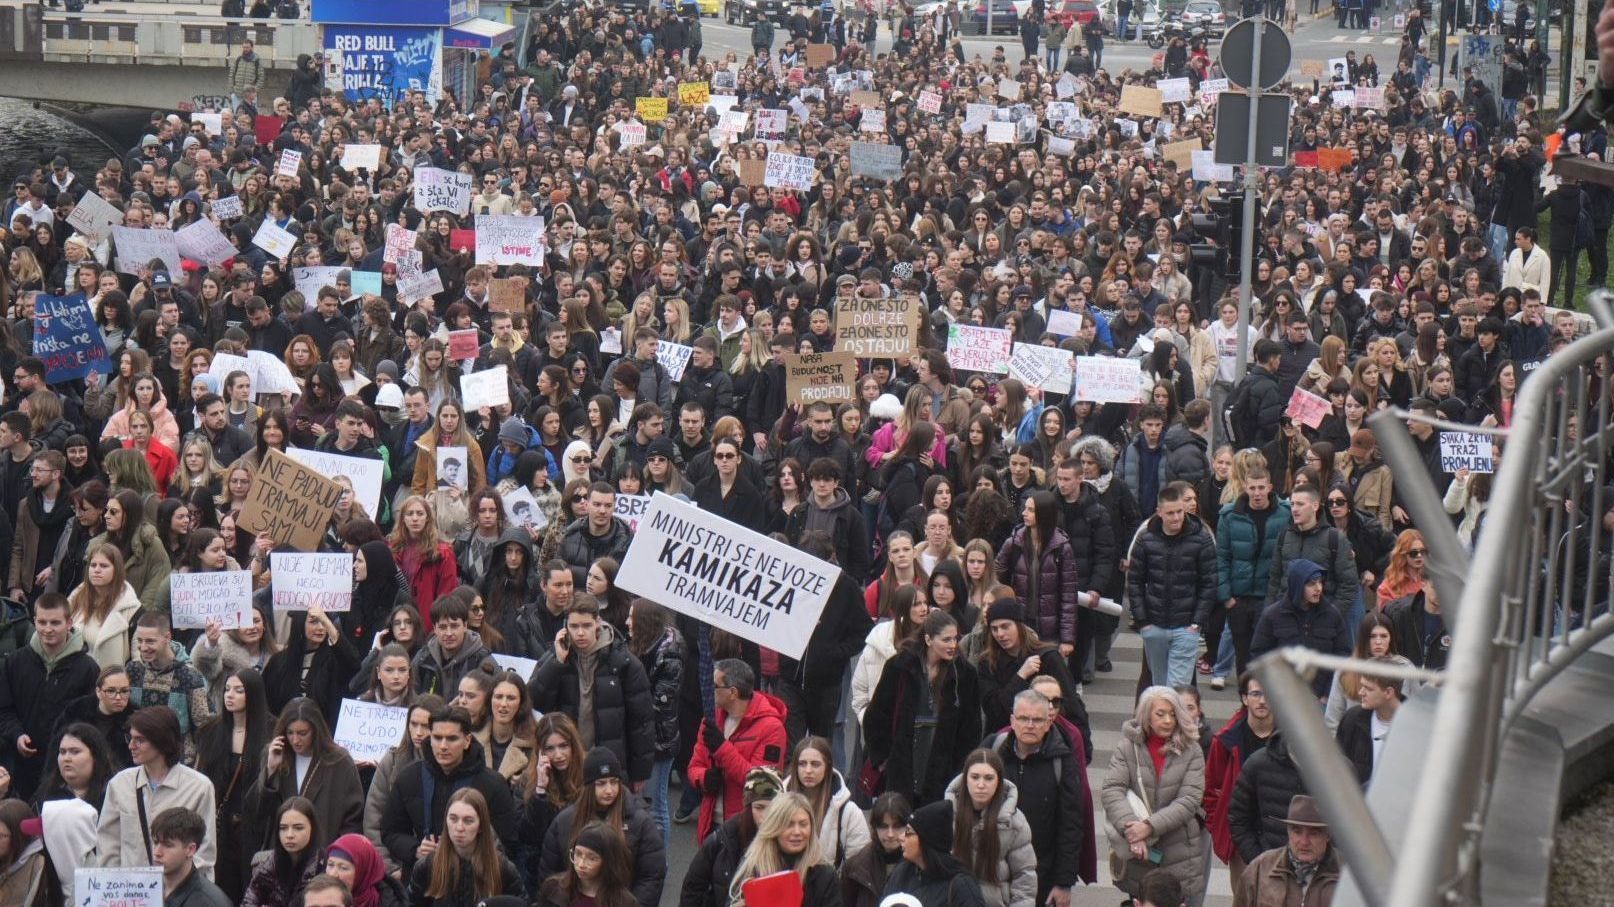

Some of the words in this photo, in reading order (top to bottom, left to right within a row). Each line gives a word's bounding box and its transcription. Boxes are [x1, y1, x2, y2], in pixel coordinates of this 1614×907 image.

[335, 35, 361, 51] RED
[365, 35, 396, 51] BULL
[344, 54, 369, 71] AJE
[455, 174, 472, 189] bori
[447, 186, 458, 198] VI
[840, 299, 858, 312] ZA
[861, 299, 885, 312] ONE
[840, 327, 857, 339] ZA
[857, 326, 883, 339] ONE
[844, 338, 910, 354] OSTAJU!
[810, 375, 829, 386] NIJE
[832, 374, 844, 384] NA
[1441, 432, 1465, 444] SVAKA
[1442, 456, 1493, 472] PROMJENU
[262, 455, 292, 486] NE
[290, 470, 344, 509] PADAJU
[256, 479, 323, 532] TRAMVAJI
[252, 511, 297, 545] SAMI
[651, 510, 732, 557] MINISTRI
[732, 543, 756, 567] SE
[755, 553, 781, 577] NE
[782, 561, 827, 595] VOZE
[278, 556, 304, 573] NIJE
[311, 556, 351, 576] NEMAR
[192, 574, 228, 589] BROJEVA
[296, 576, 324, 589] NEGO
[658, 538, 797, 615] KAMIKAZA
[198, 587, 230, 601] MOGAO
[665, 572, 771, 631] TRAMVAJEM
[172, 603, 193, 616] BITI
[197, 602, 221, 615] BILO
[343, 705, 362, 718] NE
[358, 721, 397, 738] ČUDO
[87, 877, 101, 891] Ne
[106, 880, 144, 890] zanima
